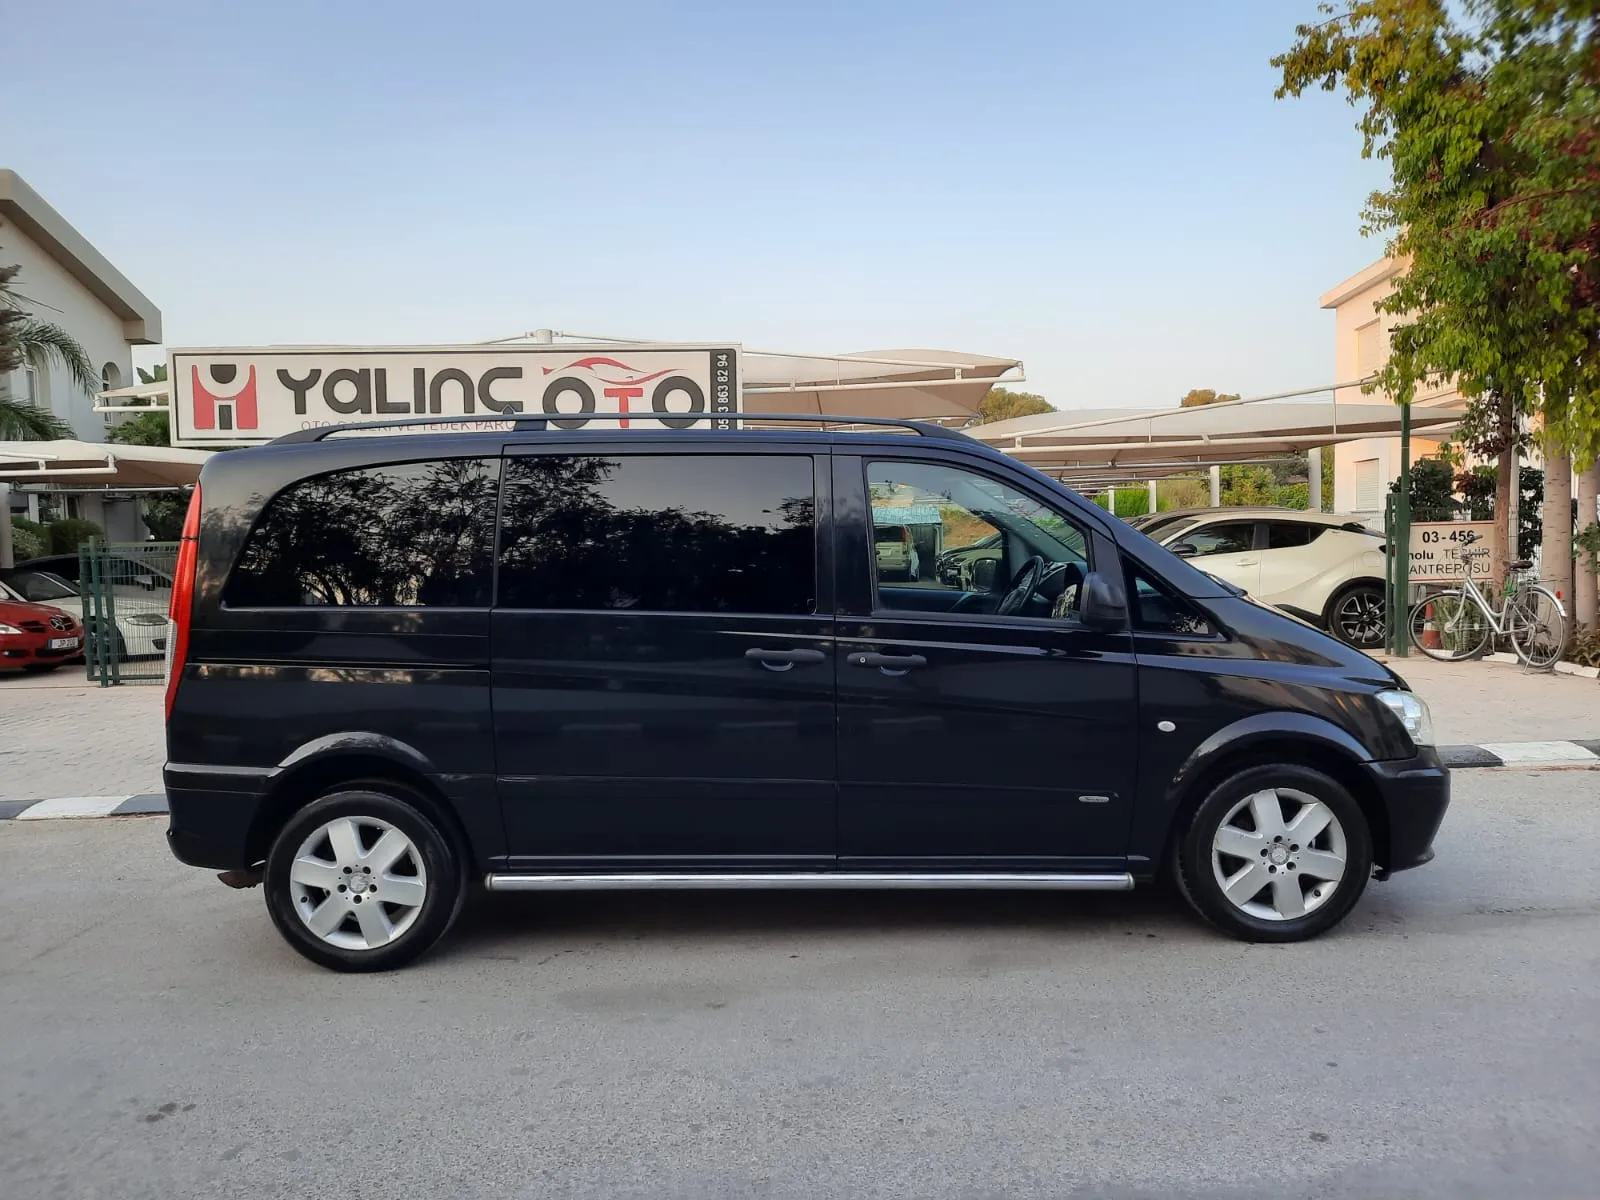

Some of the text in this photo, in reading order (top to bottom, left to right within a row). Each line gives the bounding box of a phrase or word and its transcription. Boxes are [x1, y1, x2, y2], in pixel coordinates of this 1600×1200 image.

[542, 376, 705, 429] OTO
[716, 353, 729, 430] 053 863 82 94
